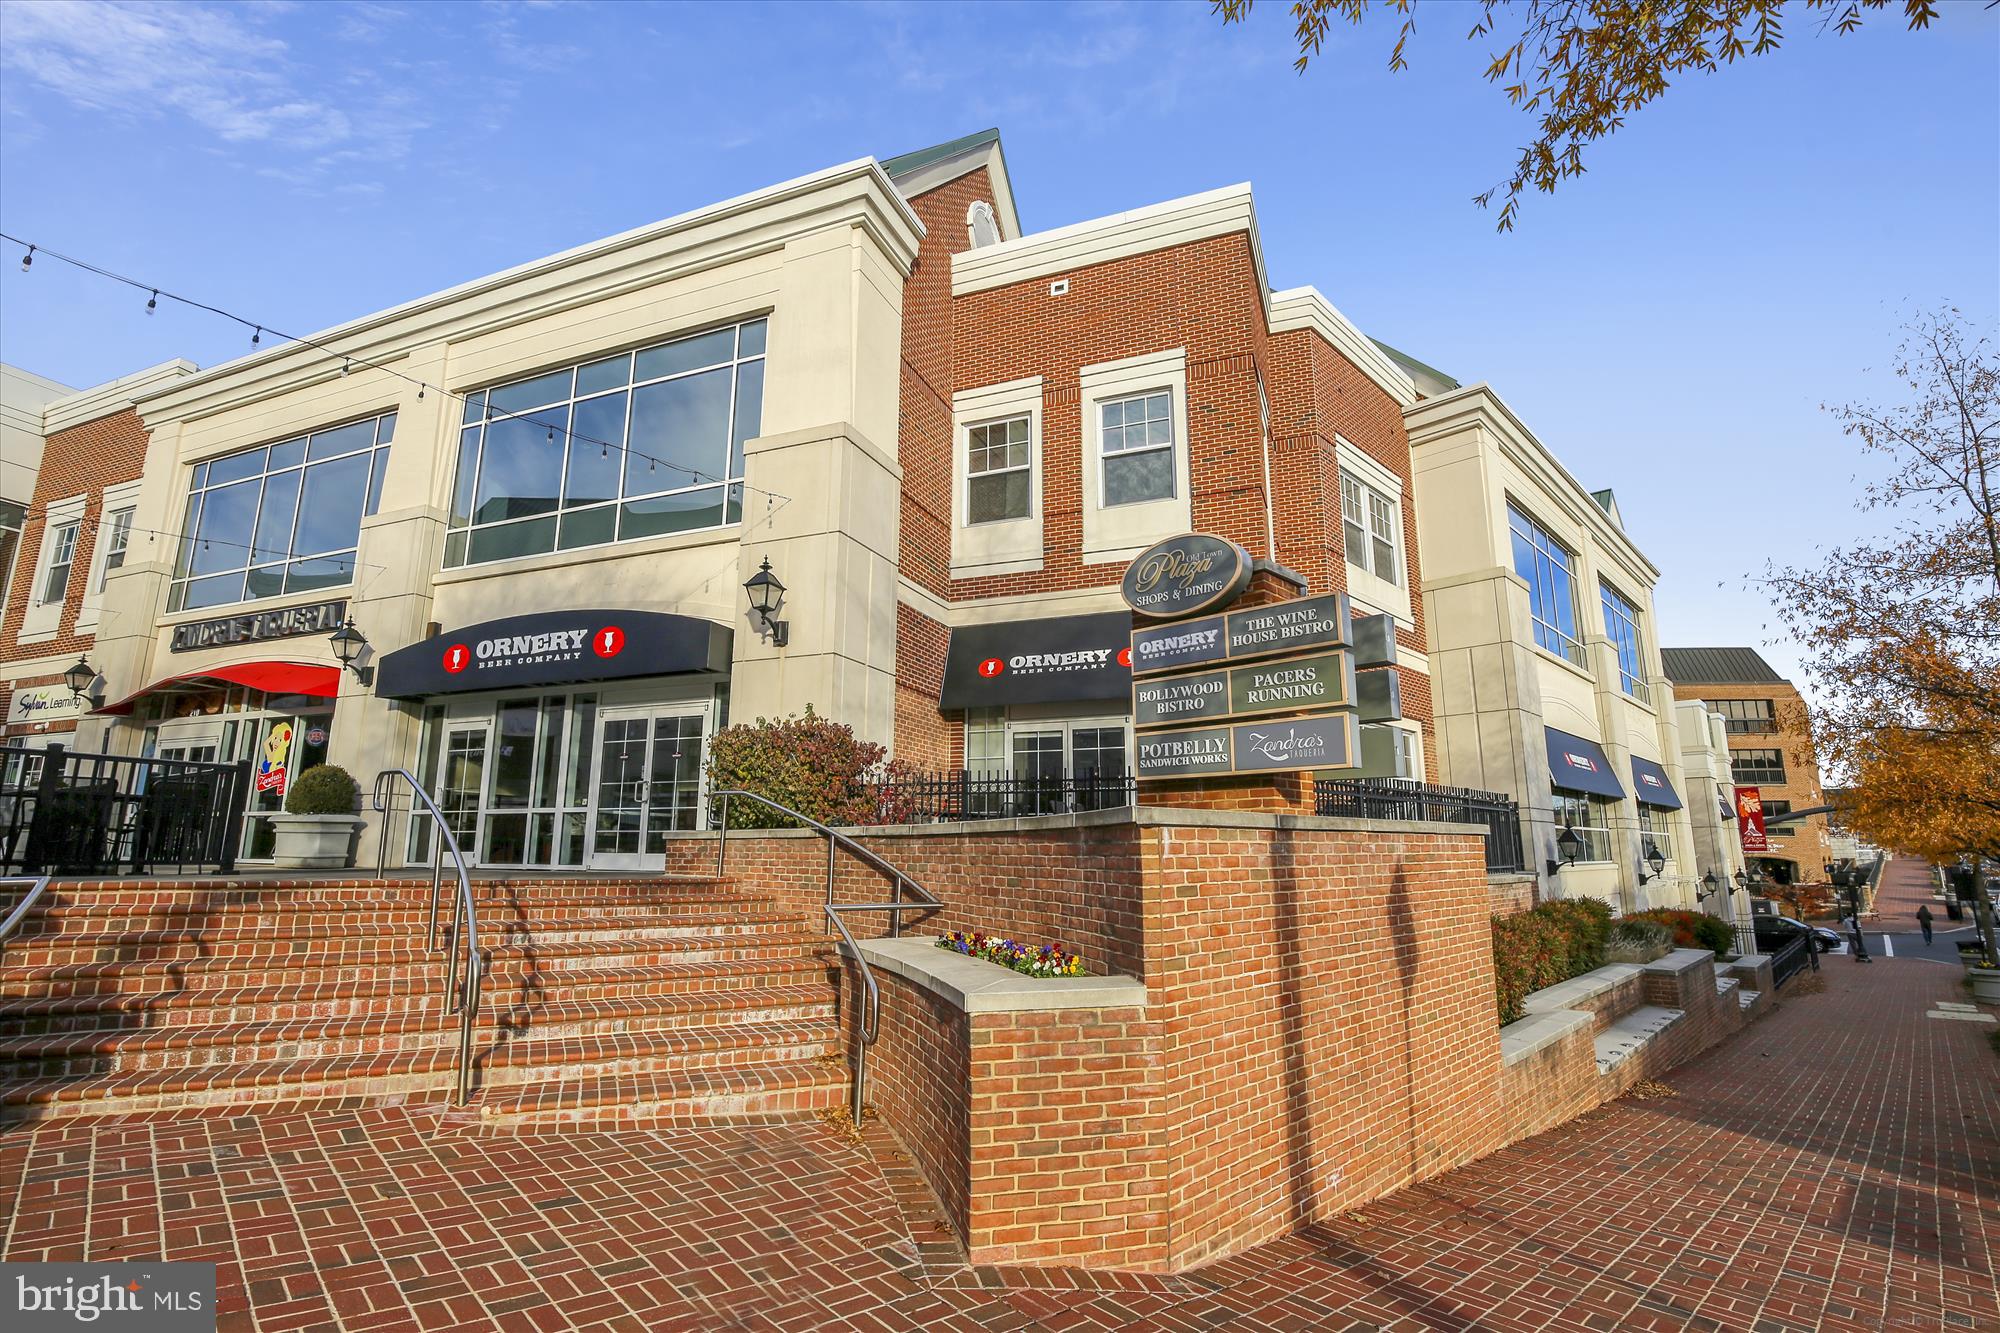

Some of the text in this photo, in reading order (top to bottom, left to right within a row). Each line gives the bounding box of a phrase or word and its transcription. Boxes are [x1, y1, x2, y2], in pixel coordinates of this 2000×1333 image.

[1186, 550, 1223, 562] Old Town
[1136, 549, 1213, 592] Plaza
[1136, 580, 1223, 607] SHOPS & DINING
[252, 604, 337, 639] TAQUERIA
[1245, 609, 1318, 631] THE WINE
[476, 629, 588, 659] ORNERY
[1139, 629, 1218, 655] ORNERY
[1232, 619, 1334, 647] HOUSE BISTRO
[479, 652, 581, 669] BEER COMPANY
[1009, 649, 1112, 669] ORNERY
[1142, 643, 1215, 660] BEER COMPANY
[1049, 663, 1107, 673] COMPANY
[1253, 667, 1316, 688] PACERS
[1139, 681, 1223, 703] BOLLYWOOD
[1247, 682, 1325, 704] RUNNING
[18, 694, 80, 718] Sylvan Learning
[1157, 698, 1205, 714] BISTRO
[1140, 737, 1226, 759] POTBELLY
[1249, 728, 1324, 761] Zandra's
[1290, 747, 1326, 758] TAQUERIA
[1140, 753, 1228, 769] SANDWICH WORKS
